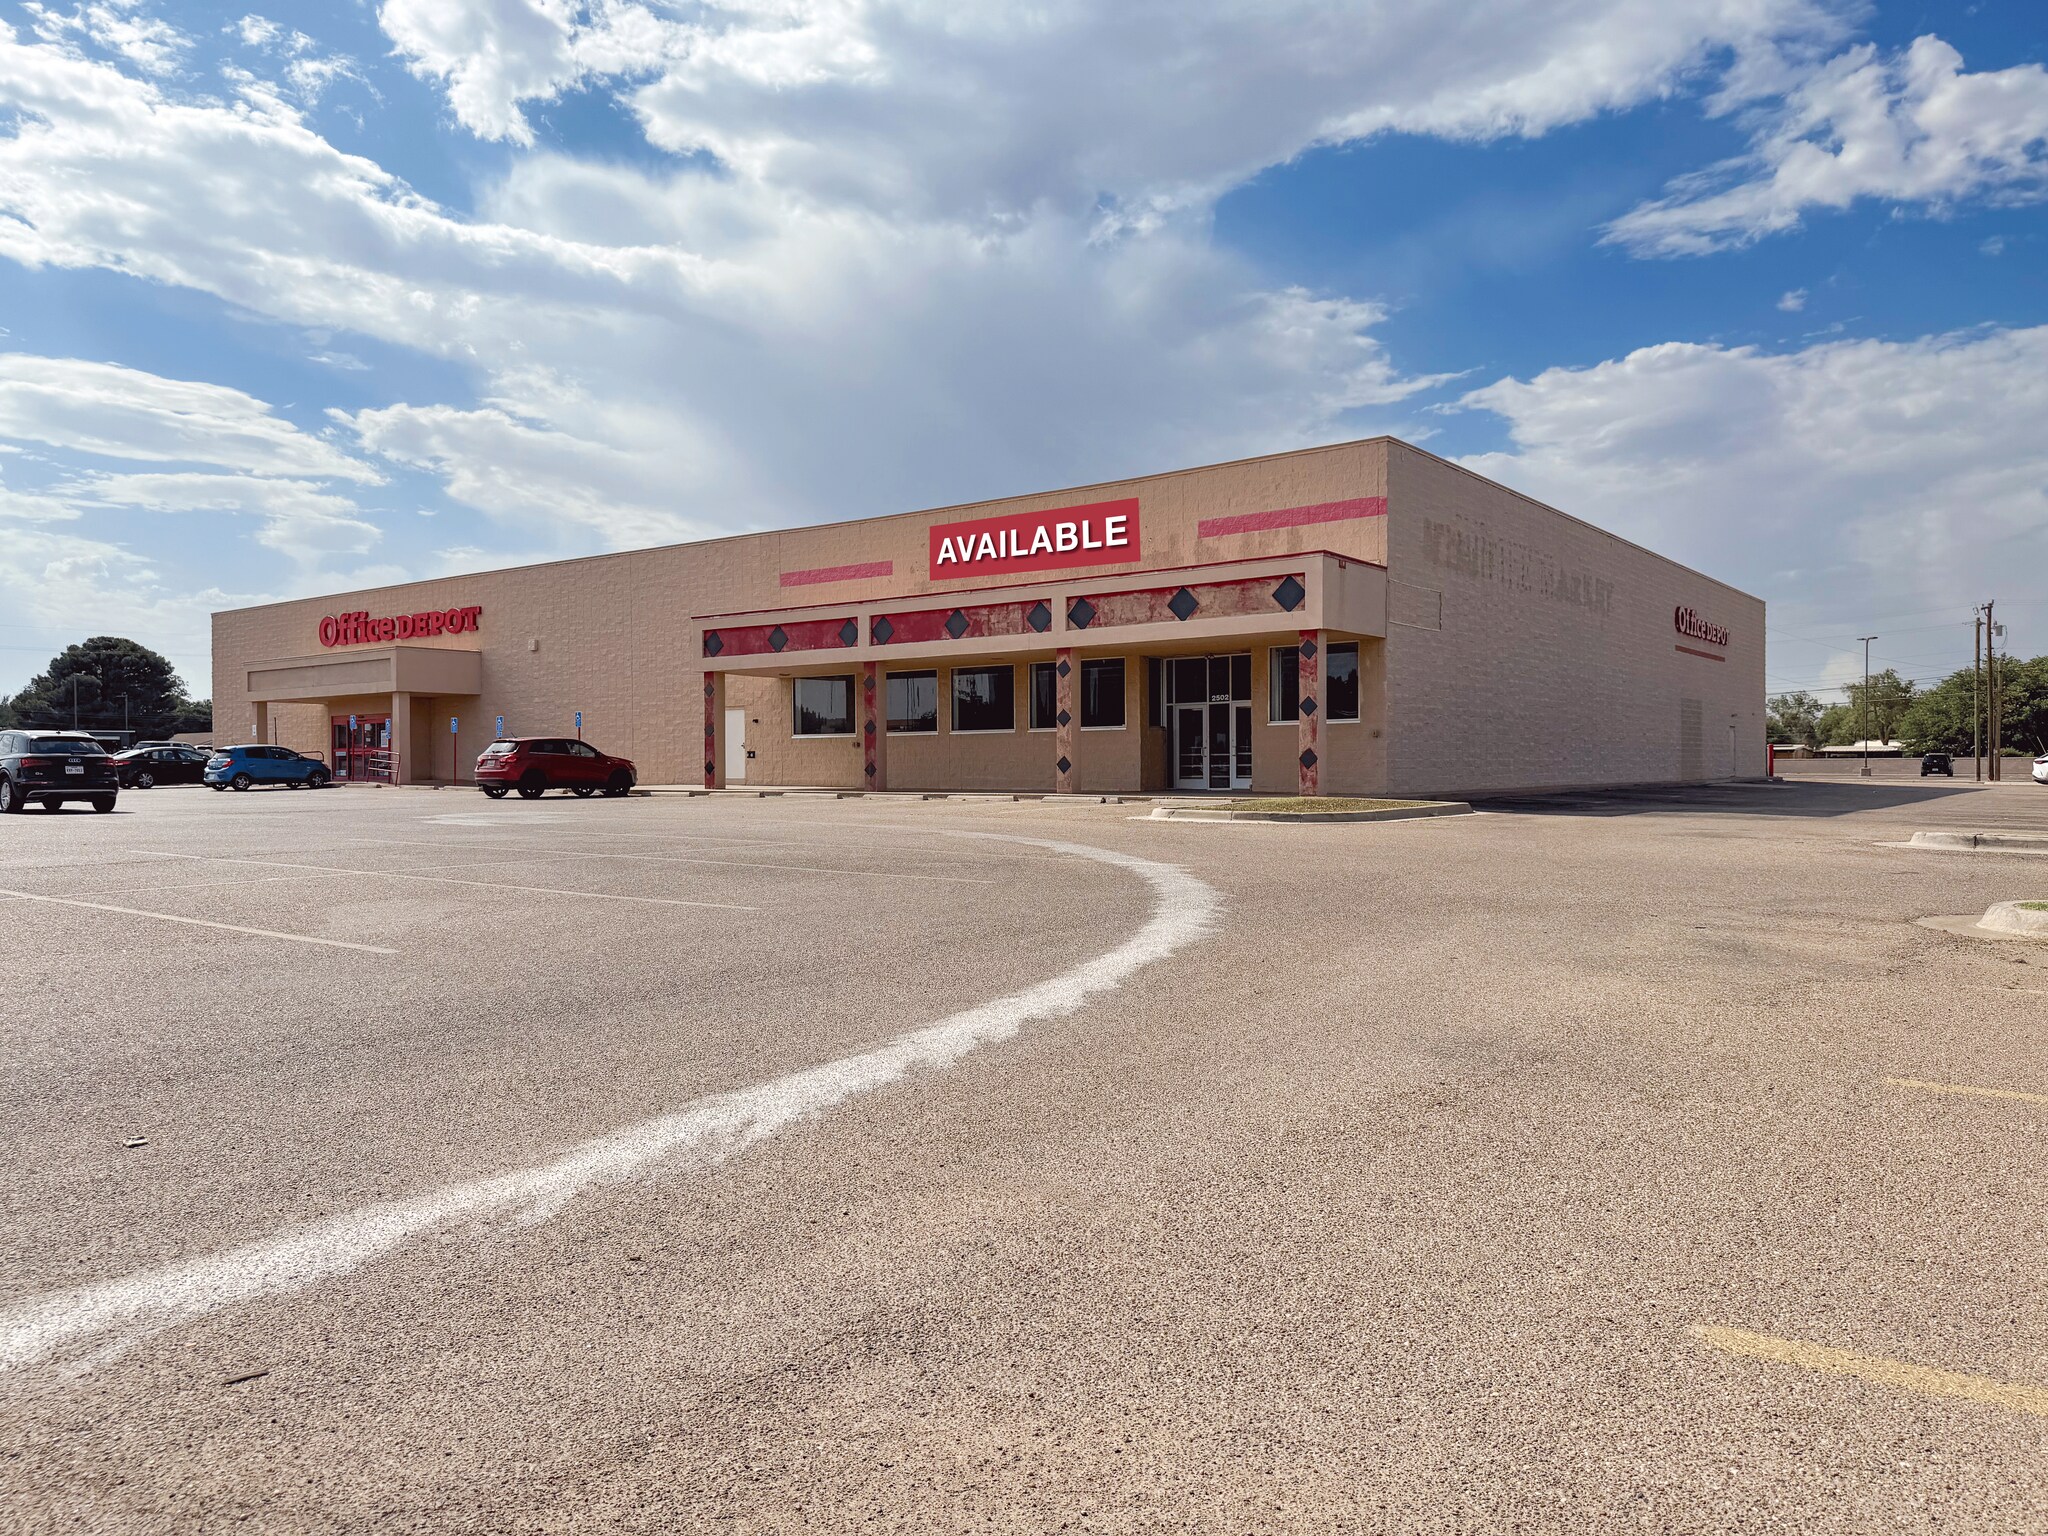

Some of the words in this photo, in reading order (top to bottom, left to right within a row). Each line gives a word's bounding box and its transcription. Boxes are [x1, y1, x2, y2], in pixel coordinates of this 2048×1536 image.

[319, 611, 395, 647] Office
[396, 606, 481, 639] DEPOT
[1675, 606, 1706, 639] Office
[1706, 623, 1730, 646] DEPOT
[1211, 694, 1229, 702] 2502
